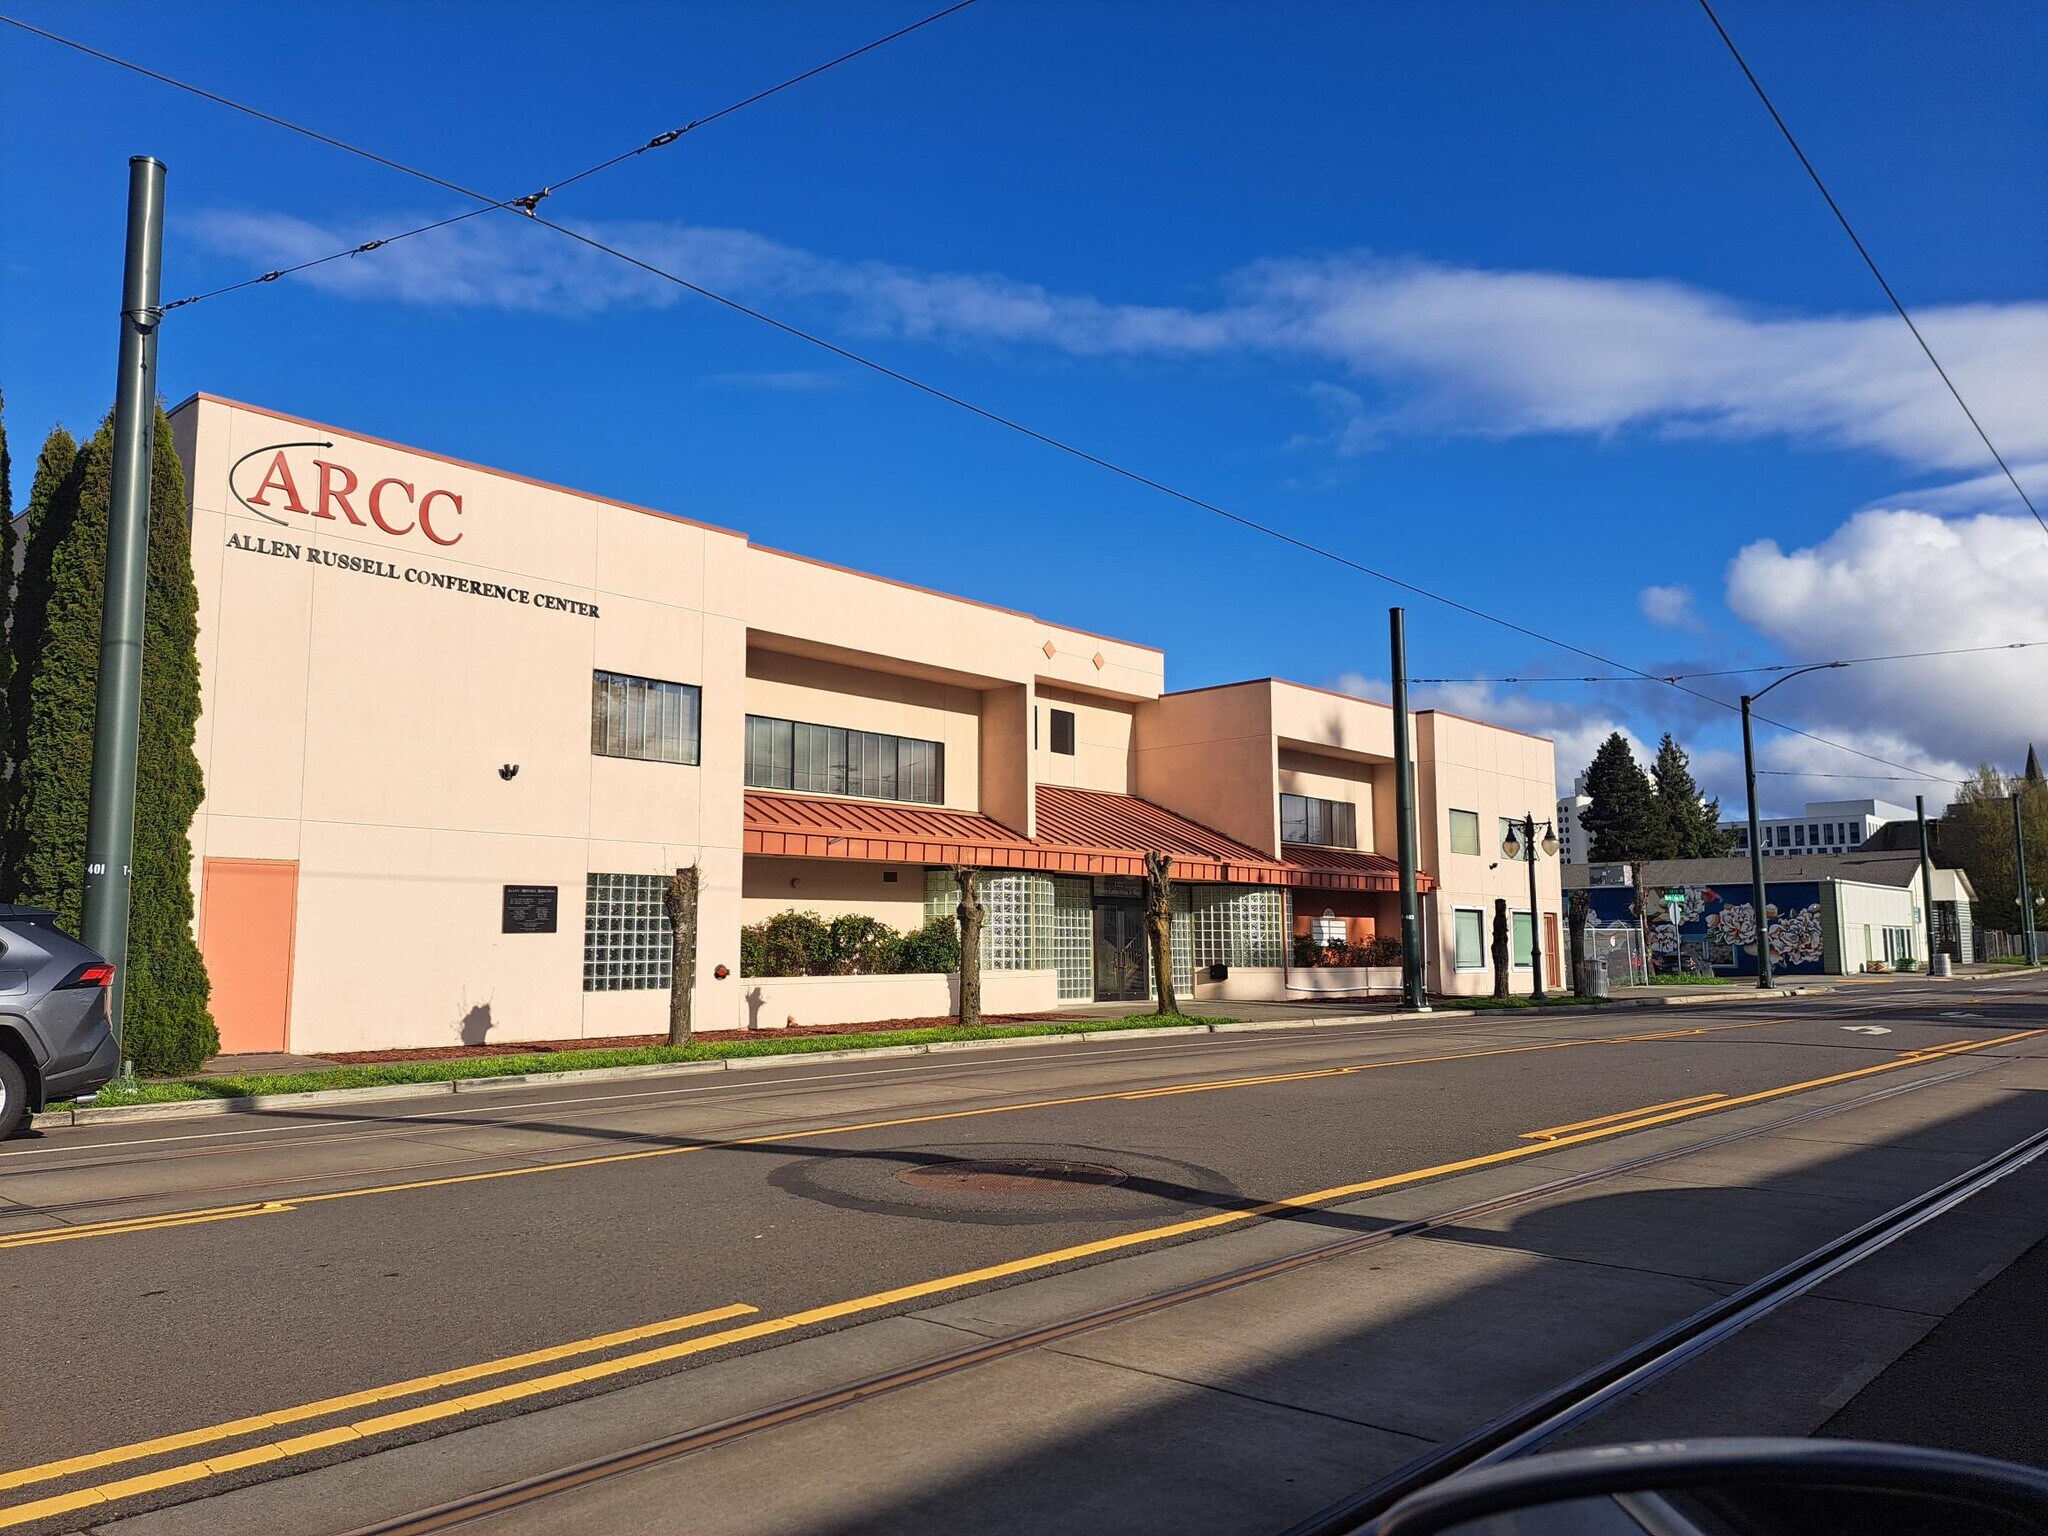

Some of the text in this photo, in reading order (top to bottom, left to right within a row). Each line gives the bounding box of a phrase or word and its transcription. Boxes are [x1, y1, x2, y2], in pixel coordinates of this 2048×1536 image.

[246, 450, 463, 546] ARCC
[226, 532, 601, 619] ALLEN RUSSELL CONFERENCE CENTER
